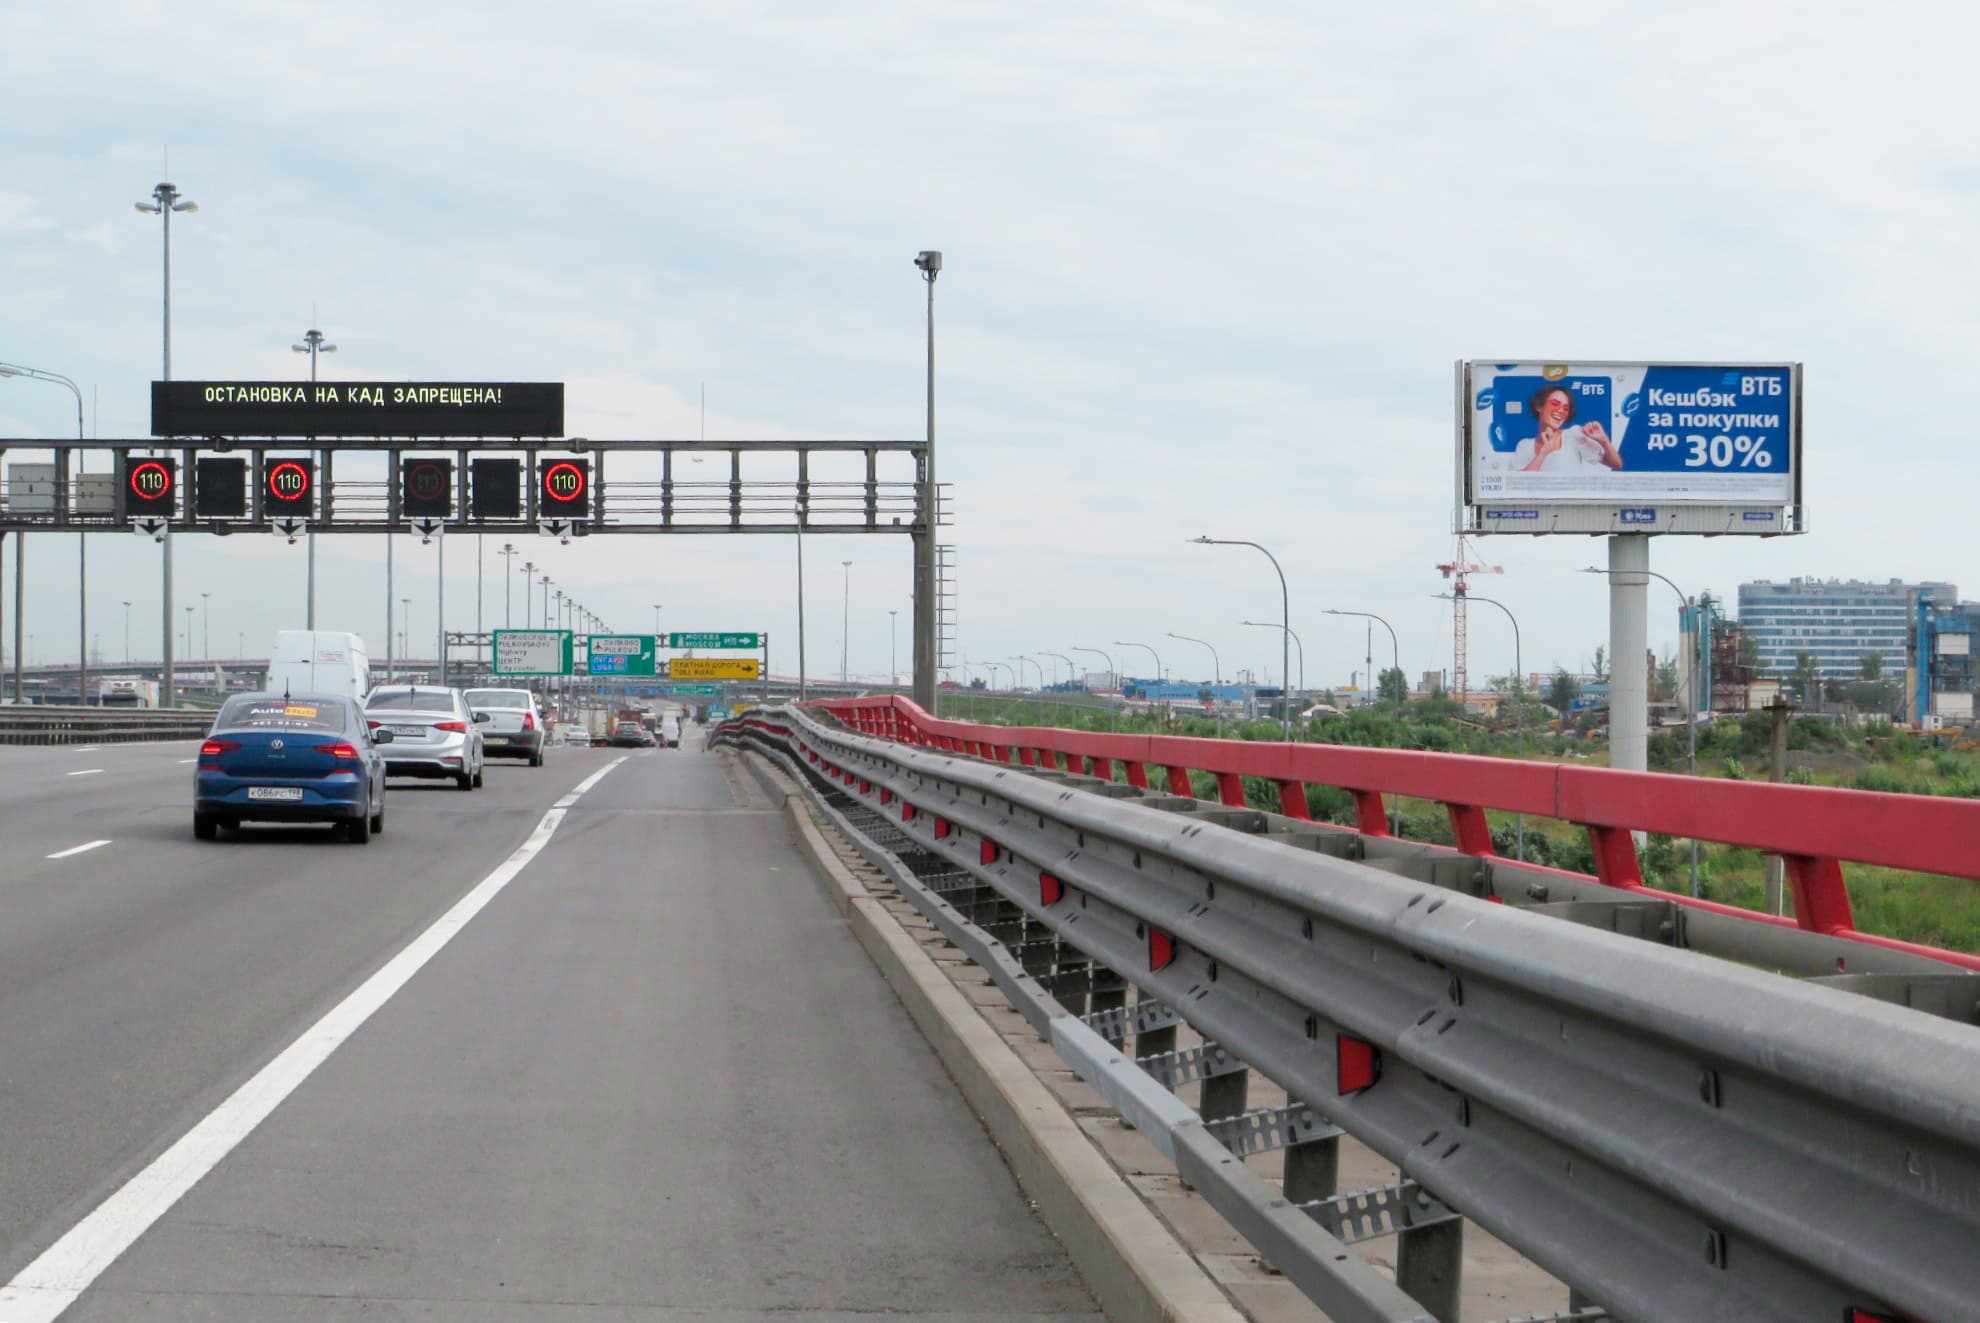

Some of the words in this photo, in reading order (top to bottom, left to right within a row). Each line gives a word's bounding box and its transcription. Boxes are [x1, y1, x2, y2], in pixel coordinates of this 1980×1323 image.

[1582, 383, 1605, 396] ВТБ
[1741, 375, 1782, 397] ВТБ
[205, 387, 306, 404] ОСТАНОВКА
[315, 387, 339, 404] НА
[348, 387, 384, 406] КАД
[394, 387, 502, 407] ЗАПРЕЩЕНА!
[1648, 387, 1737, 408] Кешбэк
[1648, 413, 1673, 427] за
[1679, 413, 1779, 431] покупки
[1648, 434, 1678, 451] до
[1685, 436, 1772, 468] 30%
[139, 473, 163, 489] 110
[277, 475, 302, 491] 110
[553, 475, 577, 491] 110
